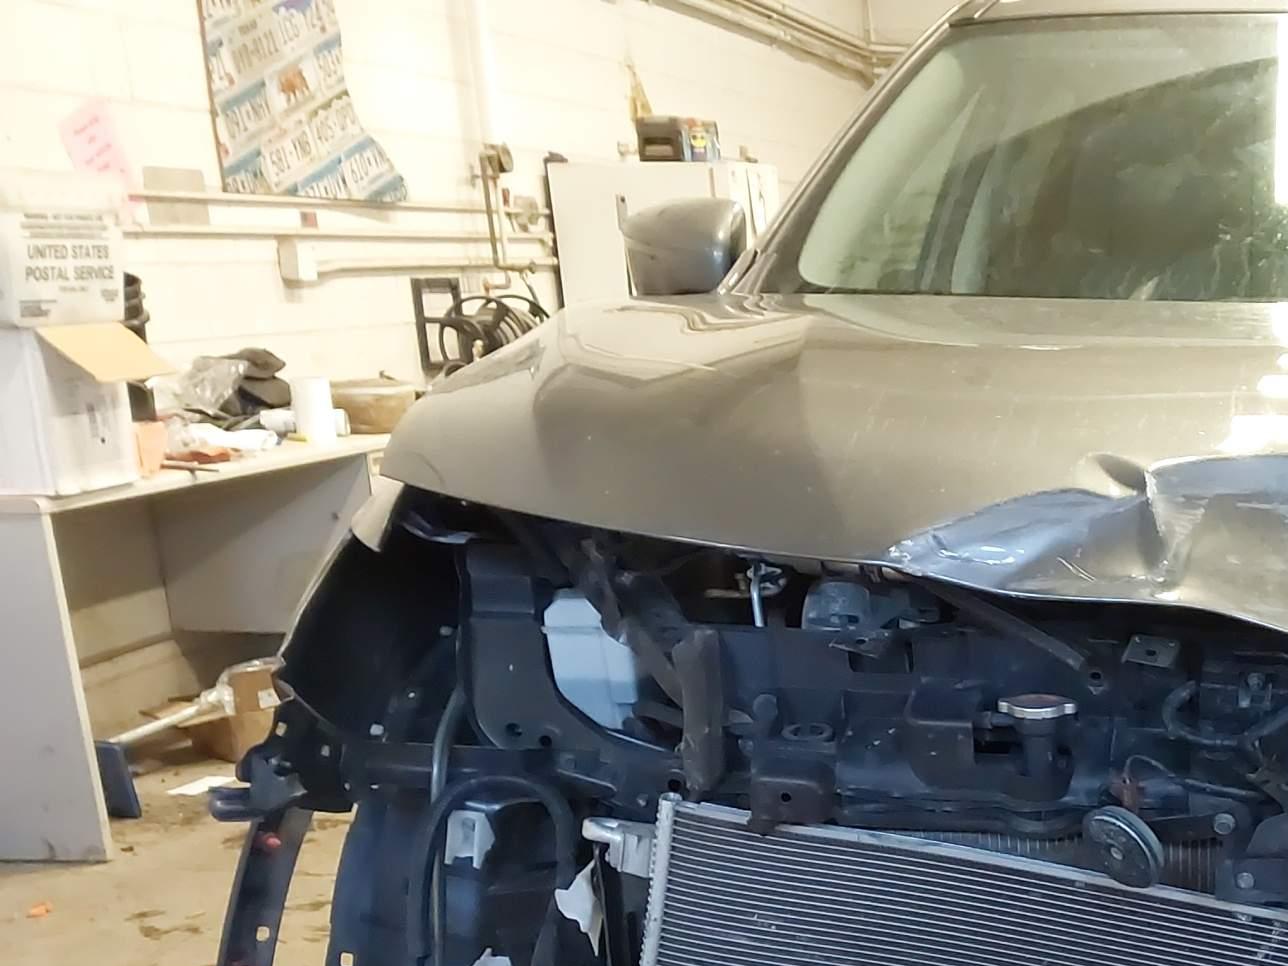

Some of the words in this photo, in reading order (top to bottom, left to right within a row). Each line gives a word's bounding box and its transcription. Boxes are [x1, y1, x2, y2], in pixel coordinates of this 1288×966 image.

[27, 244, 68, 260] UNITED
[71, 244, 109, 260] STATES
[25, 265, 69, 282] POSTAL
[73, 265, 115, 280] SERVICE
